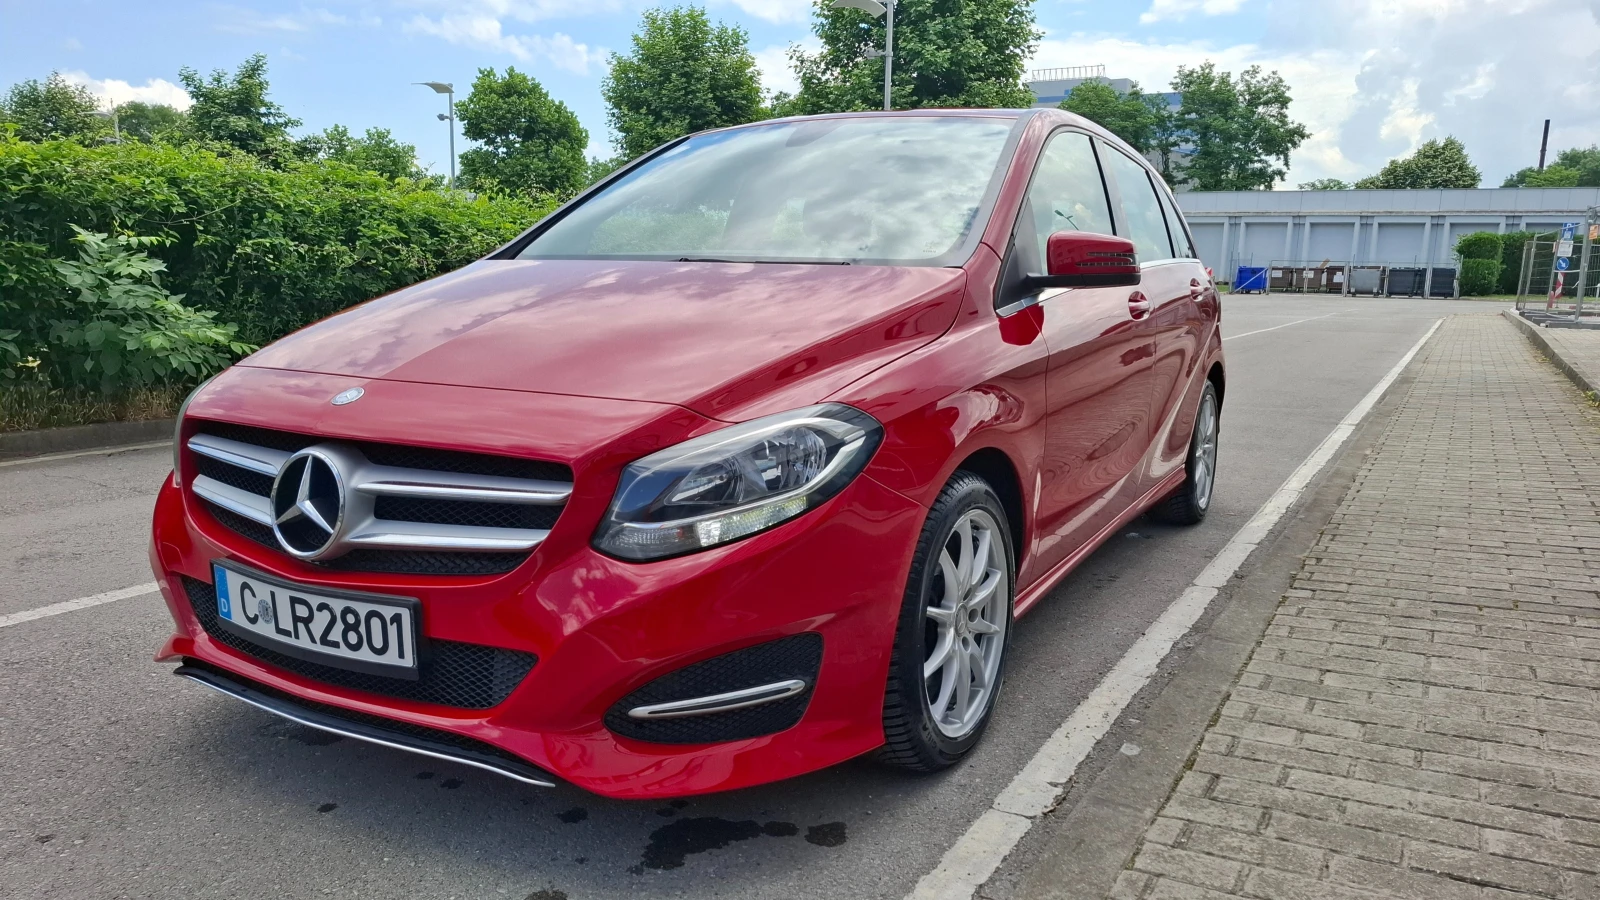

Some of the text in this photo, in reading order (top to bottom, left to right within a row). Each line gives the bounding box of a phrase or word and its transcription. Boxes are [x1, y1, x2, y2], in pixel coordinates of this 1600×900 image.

[220, 597, 228, 613] D
[239, 581, 260, 625] C
[269, 590, 405, 660] LR2801
